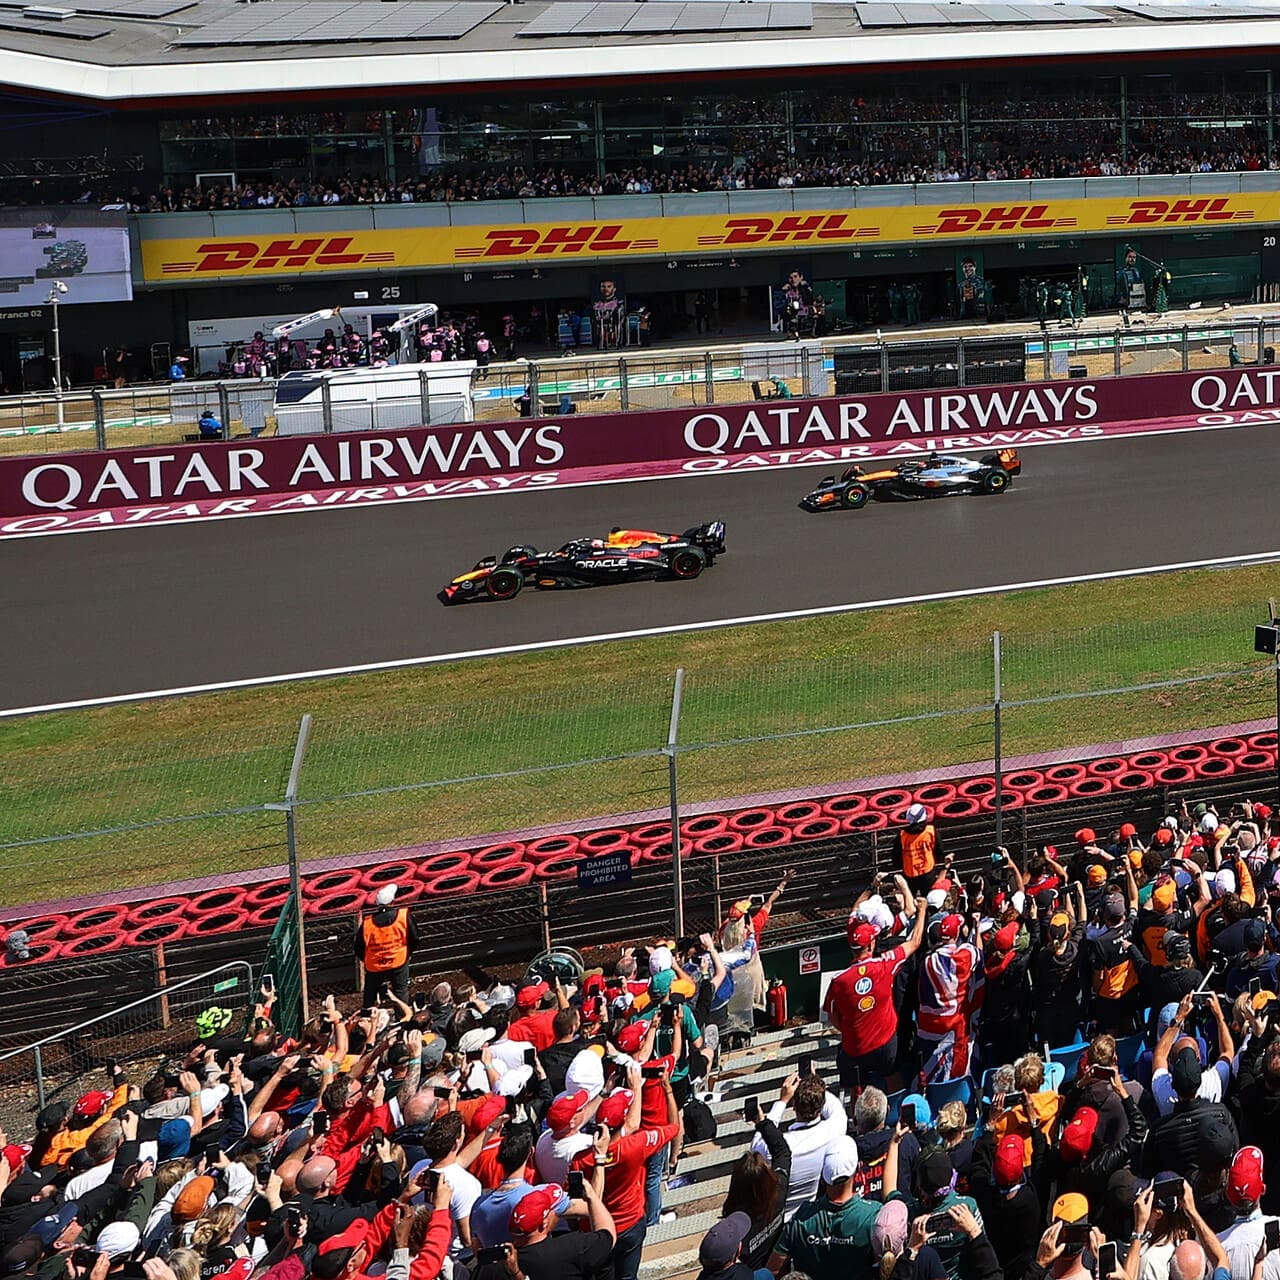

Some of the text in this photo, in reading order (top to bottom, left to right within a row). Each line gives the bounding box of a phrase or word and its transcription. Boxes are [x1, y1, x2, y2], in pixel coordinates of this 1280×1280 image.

[936, 205, 1056, 234] DHL
[1127, 198, 1236, 223] DHL
[484, 226, 632, 257] DHL
[723, 215, 856, 245] DHL
[1263, 236, 1276, 247] 20
[196, 238, 364, 271] DHL
[381, 286, 400, 299] 25
[685, 386, 1097, 454] QATAR AIRWAYS
[681, 425, 1104, 471] QATAR AIRWAYS
[23, 426, 563, 509] QATAR AIRWAYS
[0, 471, 560, 534] QATAR AIRWAYS
[575, 558, 628, 568] ORACLE
[580, 864, 629, 878] PROHIBITED
[586, 857, 621, 869] DANGER
[593, 874, 616, 884] AREA
[857, 979, 871, 993] hp
[807, 1234, 855, 1246] Cognizant
